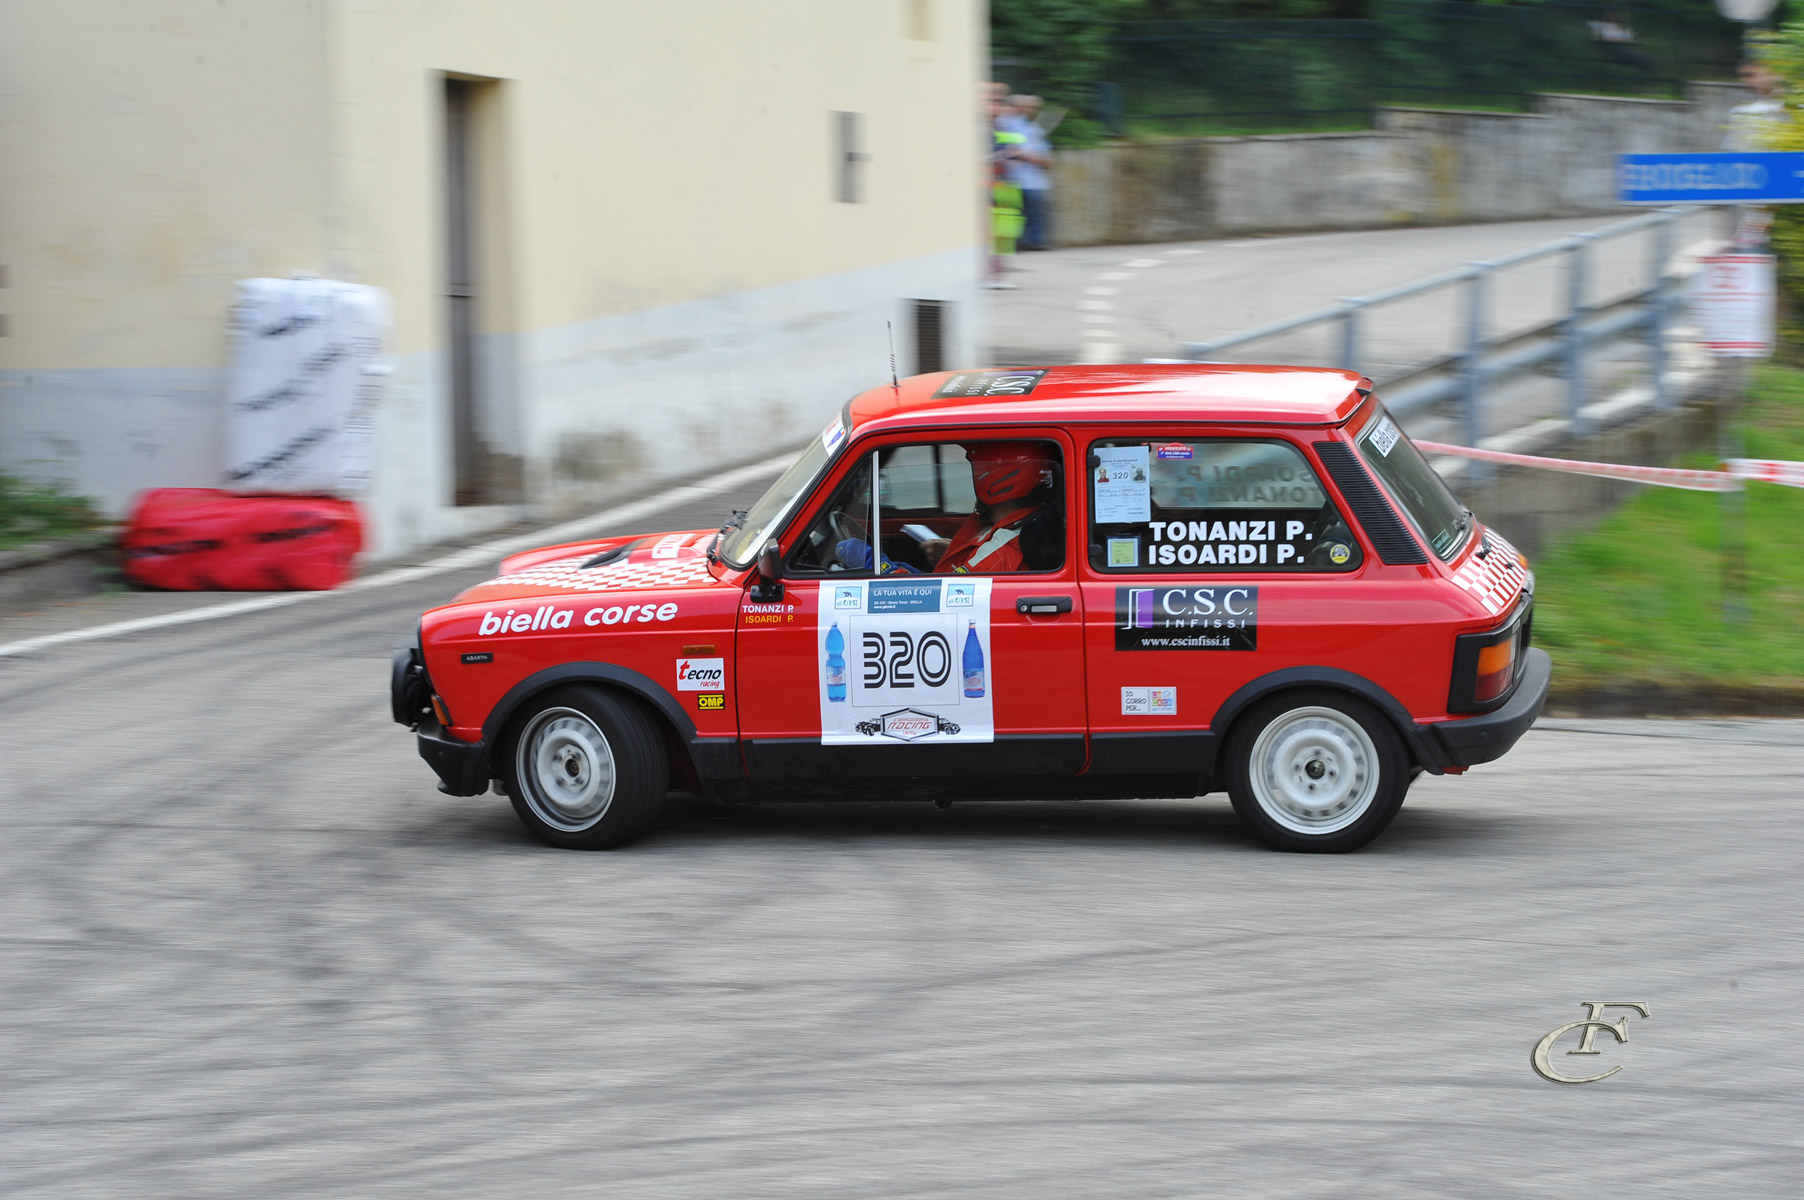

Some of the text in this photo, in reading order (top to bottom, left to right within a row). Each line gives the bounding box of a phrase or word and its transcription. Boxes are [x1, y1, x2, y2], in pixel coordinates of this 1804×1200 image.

[1112, 471, 1129, 480] 320
[1149, 520, 1313, 542] TONANZI P.
[1149, 544, 1267, 565] ISOARDI
[1276, 543, 1305, 564] P.
[1162, 588, 1254, 616] C.S.C.
[742, 604, 794, 613] TONANZI P.
[478, 602, 679, 636] biella corse
[745, 614, 794, 624] ISOARDI P.
[1165, 618, 1246, 629] INFISSI
[1140, 635, 1231, 647] www.cscinfissi.it
[862, 630, 952, 689] 320
[678, 660, 722, 680] tecno
[699, 680, 721, 689] racing
[698, 697, 724, 707] OMP
[1125, 697, 1147, 705] CORRO
[887, 721, 932, 730] RACING
